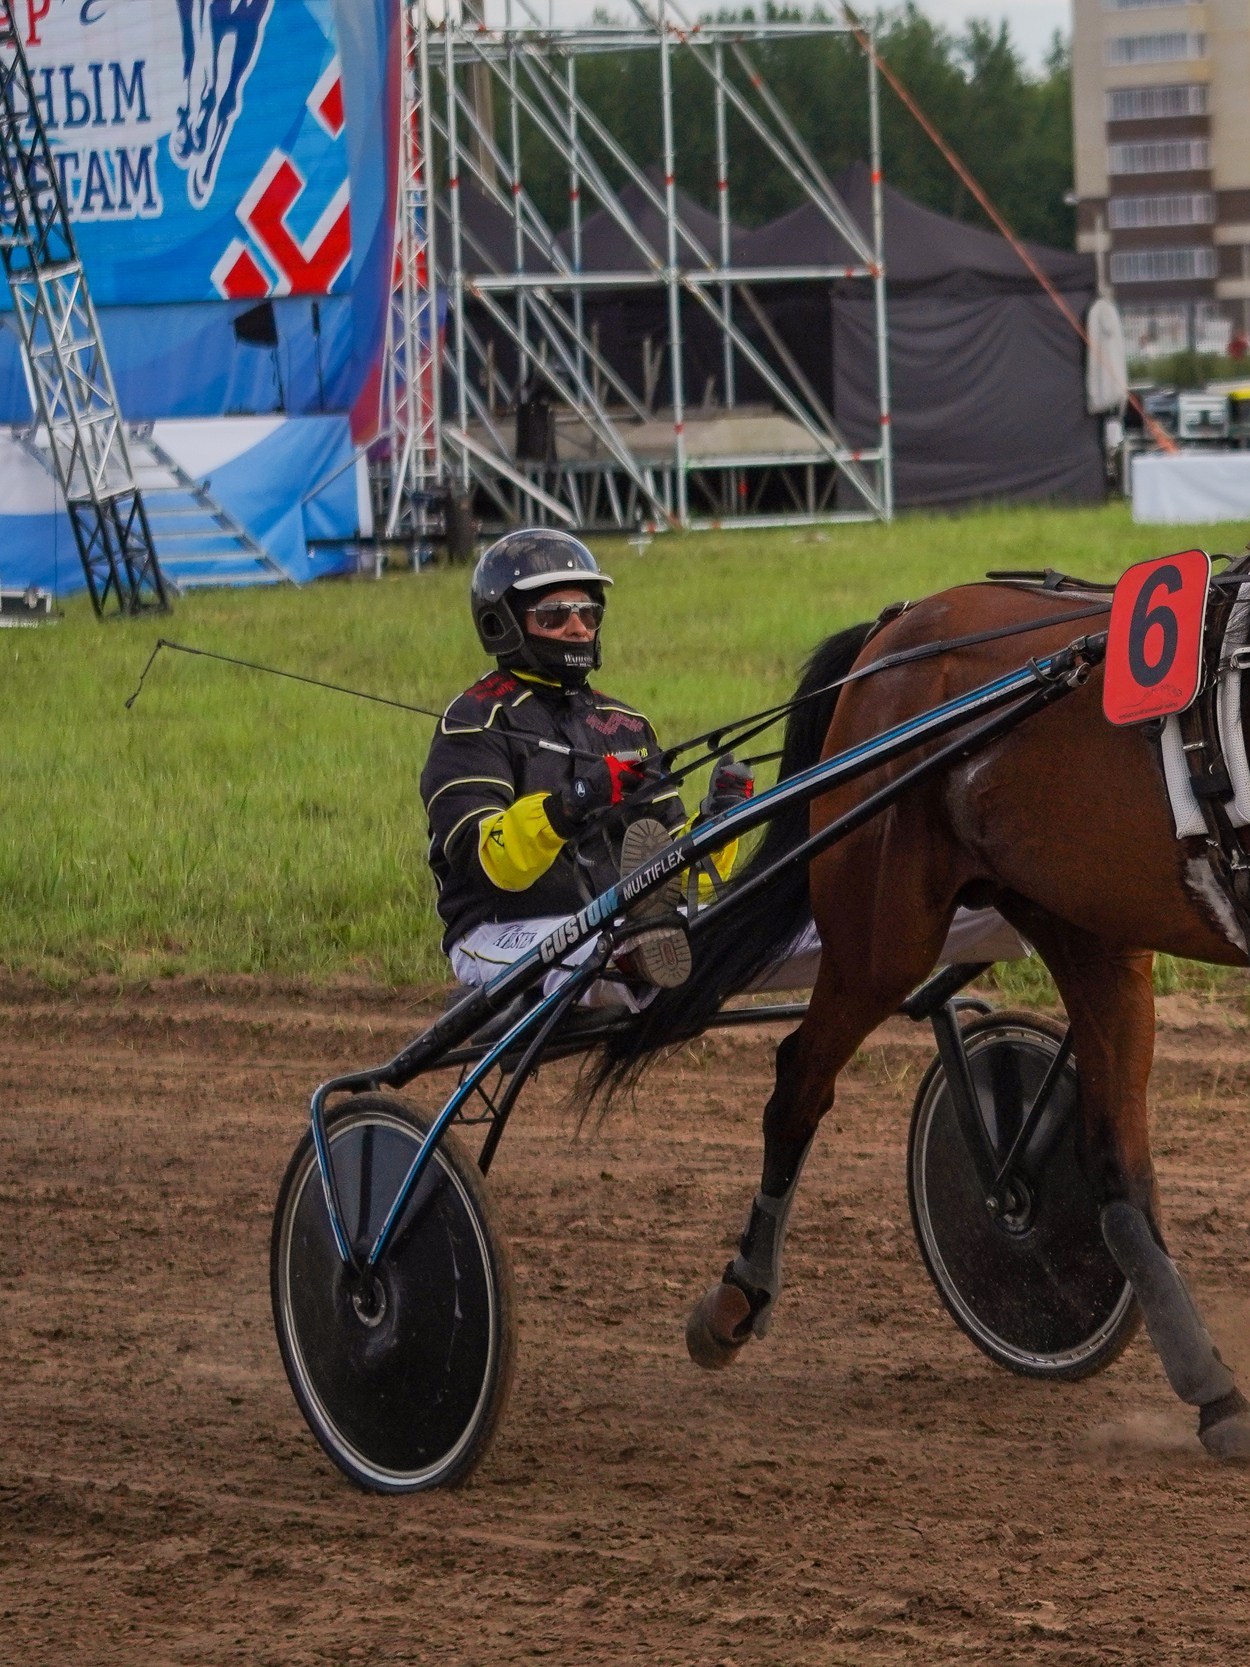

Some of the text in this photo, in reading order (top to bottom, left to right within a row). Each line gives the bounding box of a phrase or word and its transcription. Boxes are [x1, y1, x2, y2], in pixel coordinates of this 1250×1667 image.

[3, 60, 151, 132] НЫМ
[1128, 564, 1183, 688] 6
[540, 847, 686, 964] CUSTOM MULTIFLEX
